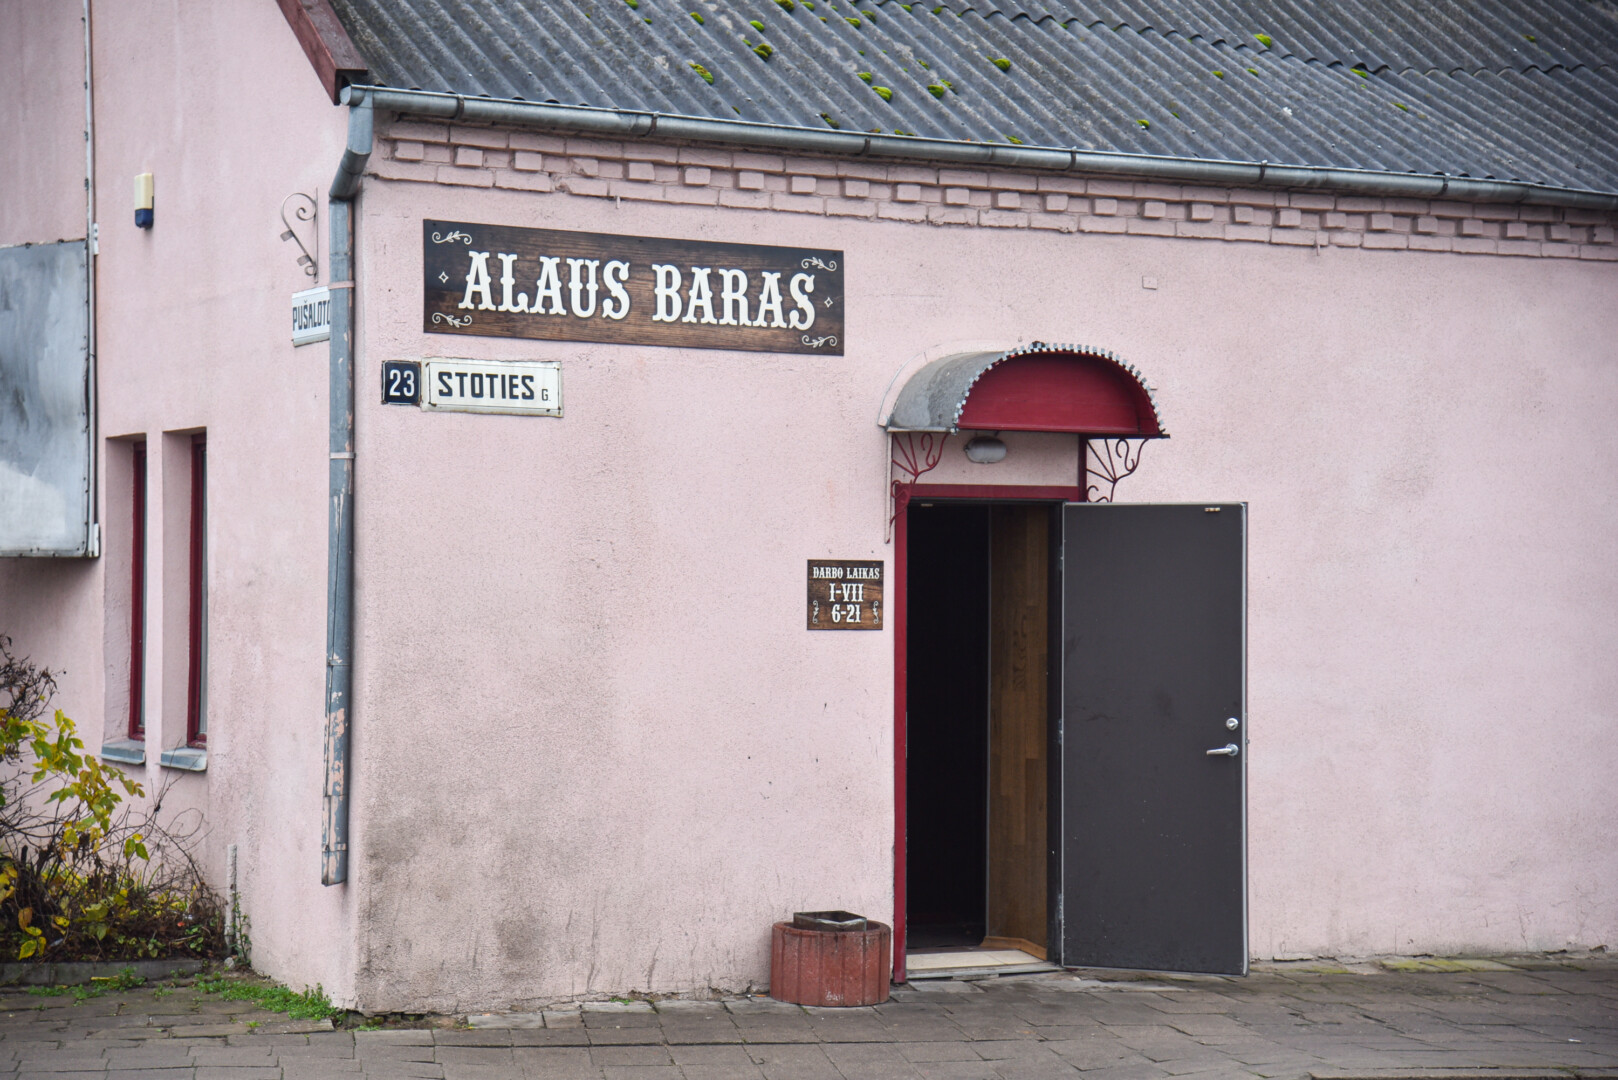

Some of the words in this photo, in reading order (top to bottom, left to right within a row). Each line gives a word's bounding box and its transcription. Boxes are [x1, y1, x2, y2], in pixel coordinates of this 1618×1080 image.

[458, 250, 630, 320] ALAUS
[651, 264, 816, 331] BARAS
[389, 369, 415, 397] 23
[438, 371, 535, 400] STOTIES
[813, 566, 843, 579] DARBO
[846, 567, 880, 579] LAIKAS
[829, 582, 864, 602] I-VII
[831, 603, 861, 623] 6-21
